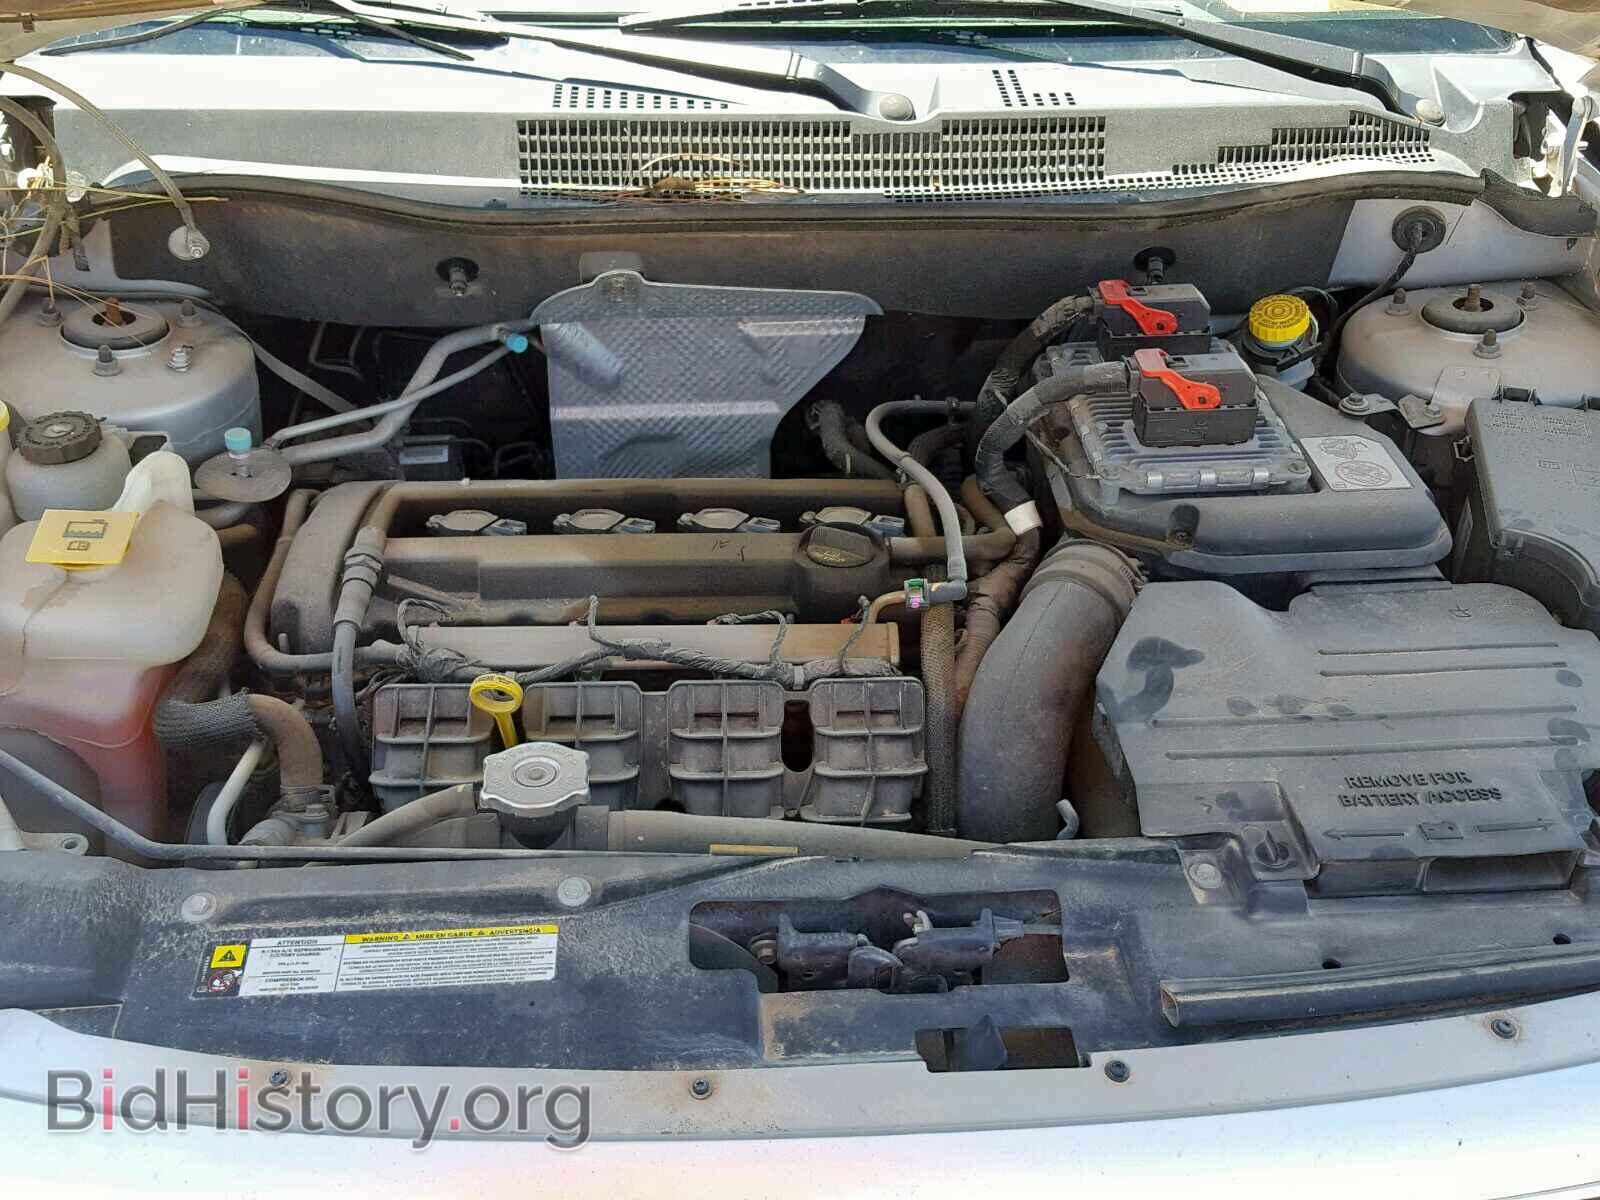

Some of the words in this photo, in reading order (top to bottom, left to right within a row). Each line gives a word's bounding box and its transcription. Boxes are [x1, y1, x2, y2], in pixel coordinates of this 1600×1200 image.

[1344, 773, 1428, 789] REMOVE
[1429, 771, 1472, 786] FOR
[1338, 791, 1420, 807] BATTERY
[1425, 787, 1502, 803] ACCESS
